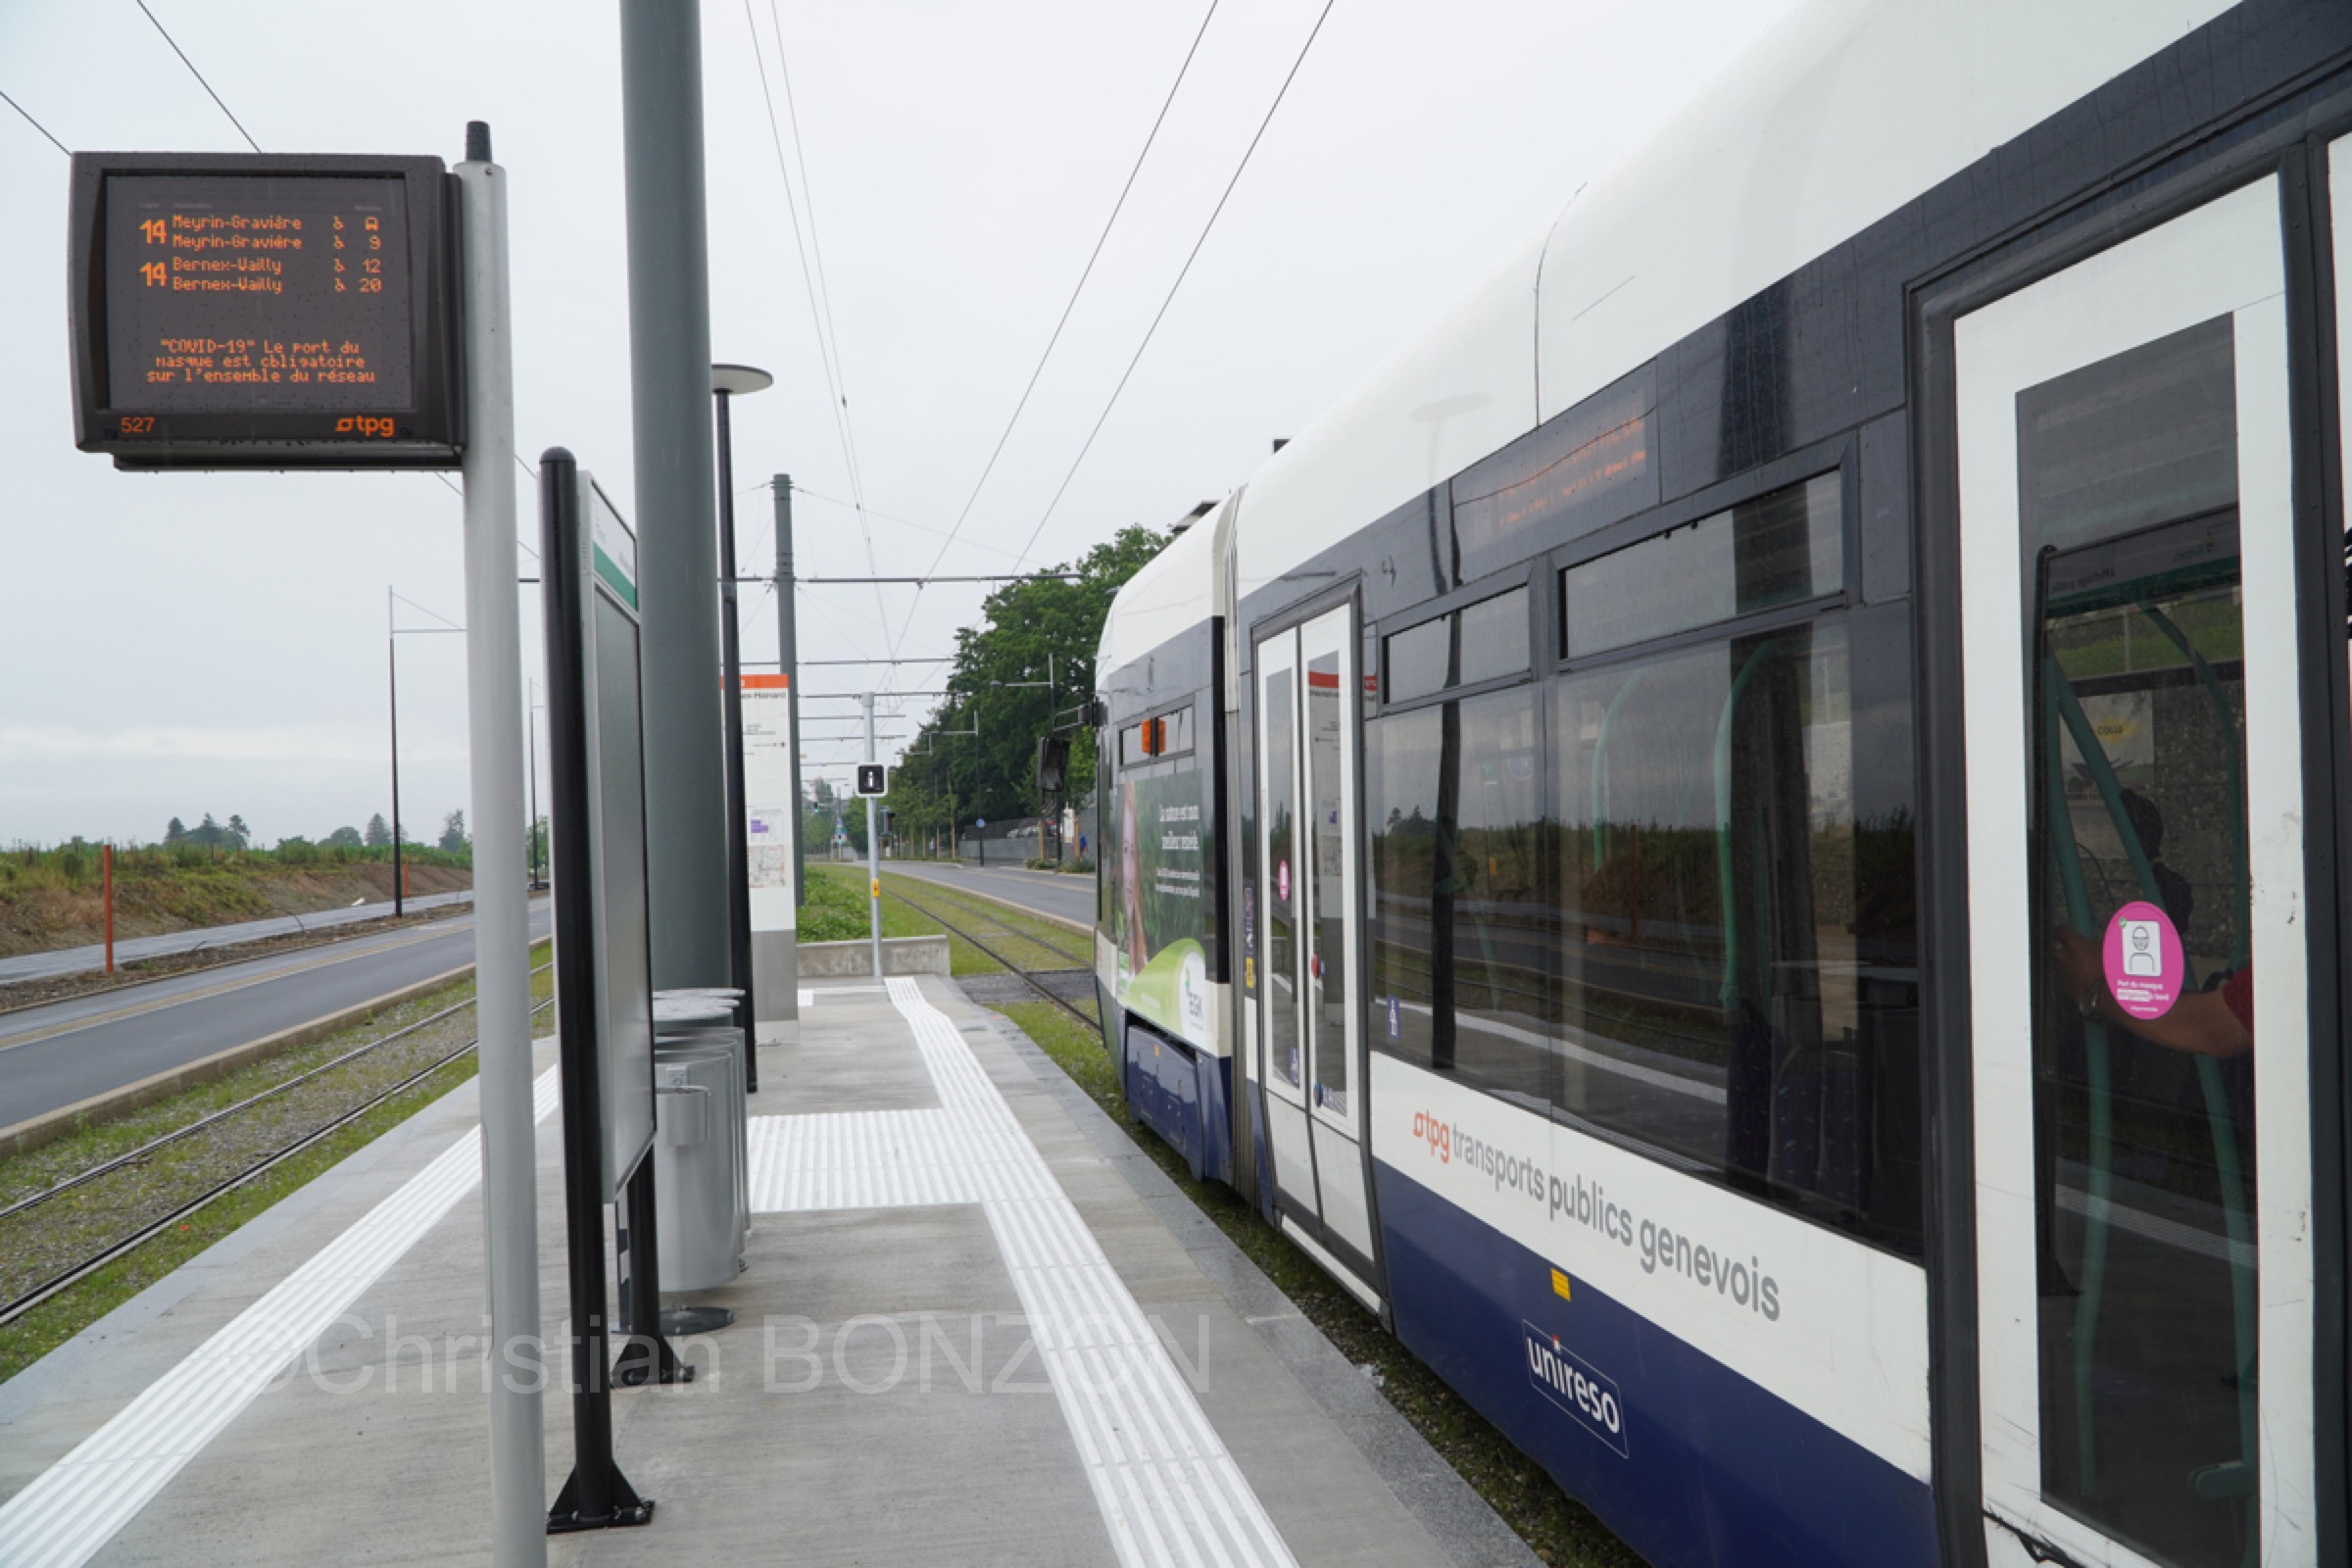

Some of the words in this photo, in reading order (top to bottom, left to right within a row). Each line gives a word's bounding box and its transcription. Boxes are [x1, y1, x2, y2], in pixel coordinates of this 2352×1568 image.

[139, 219, 168, 244] 14
[172, 213, 303, 232] Meyrin-Gravière
[172, 233, 303, 252] Meyrin-Gravière
[368, 235, 381, 250] 9
[139, 261, 168, 287] 14
[172, 256, 282, 275] Bernex-Vailly
[362, 259, 381, 273] 12
[172, 276, 282, 294] Bernex-Vailly
[359, 277, 382, 293] 20
[160, 338, 256, 354] "COVID-19"
[264, 340, 283, 354] Le
[293, 340, 330, 354] port
[340, 340, 360, 354] du
[222, 356, 251, 368] est
[147, 370, 175, 383] sur
[290, 369, 311, 383] du
[317, 368, 376, 383] réseau
[120, 416, 156, 434] 527
[1452, 1123, 1544, 1202] transports
[1549, 1174, 1633, 1247] publics
[1641, 1218, 1781, 1321] genevois
[1527, 1334, 1620, 1434] unireso
